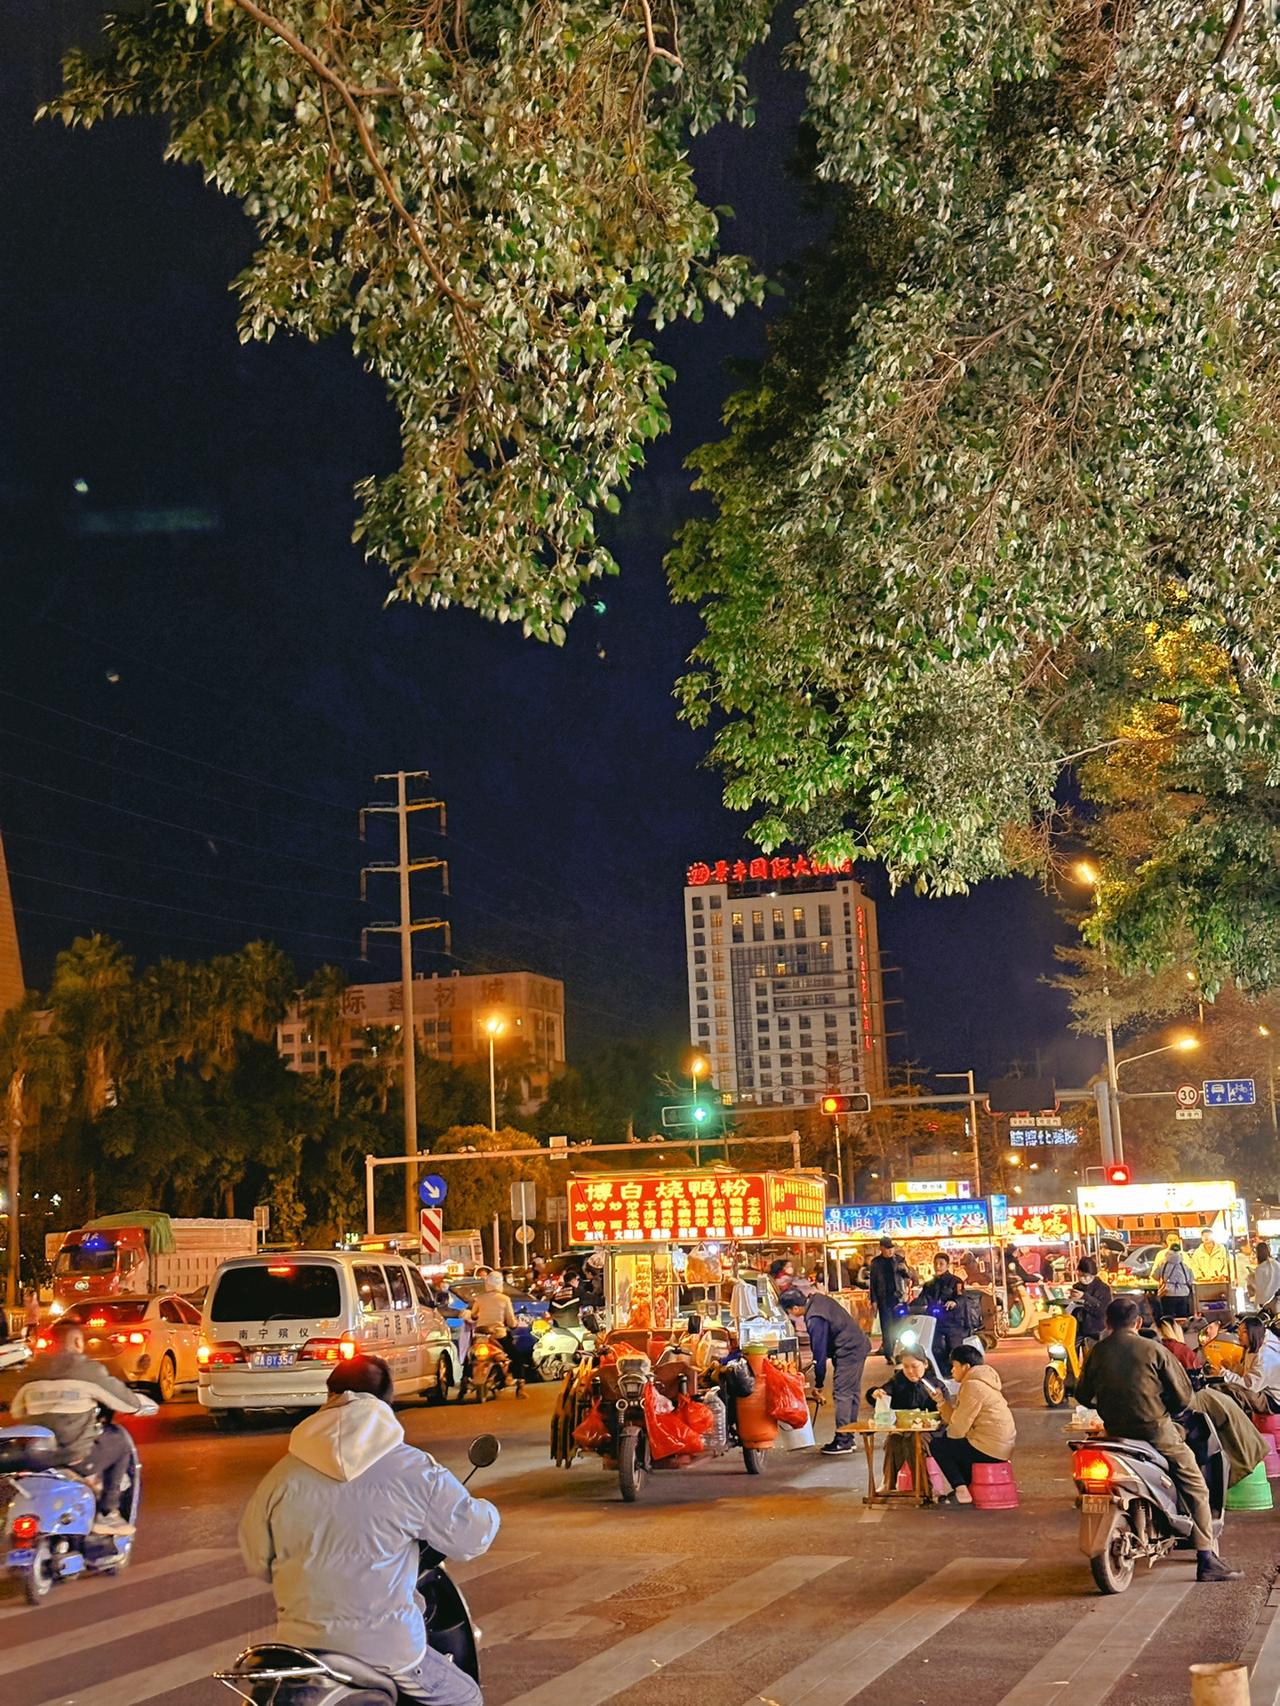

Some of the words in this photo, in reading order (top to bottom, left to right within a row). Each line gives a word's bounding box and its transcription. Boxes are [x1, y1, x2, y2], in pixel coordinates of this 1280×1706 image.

[1180, 1089, 1195, 1101] 30
[584, 1179, 751, 1201] 博白烧鸭粉
